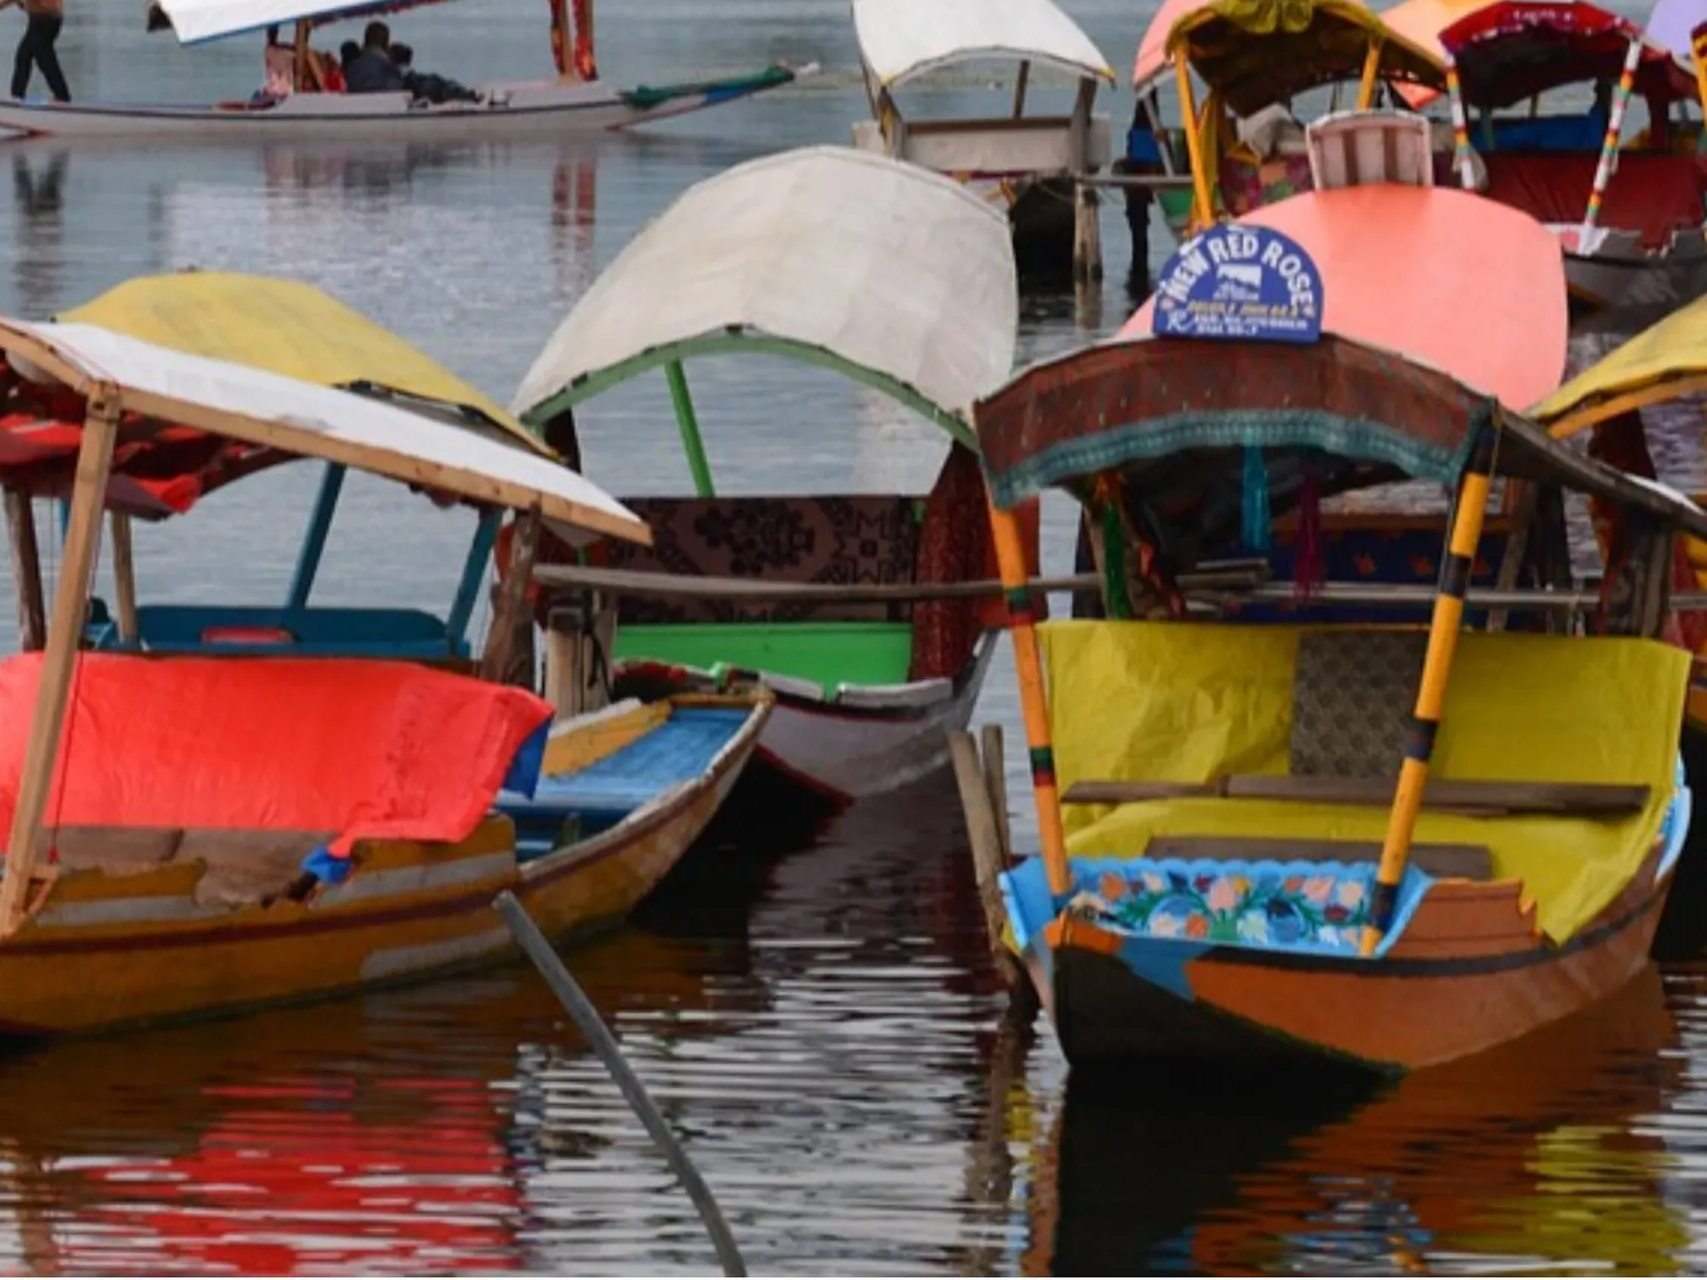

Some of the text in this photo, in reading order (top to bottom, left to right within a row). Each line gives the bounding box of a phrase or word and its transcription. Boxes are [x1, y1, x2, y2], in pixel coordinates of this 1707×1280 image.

[1165, 234, 1314, 306] NEW RED ROSE
